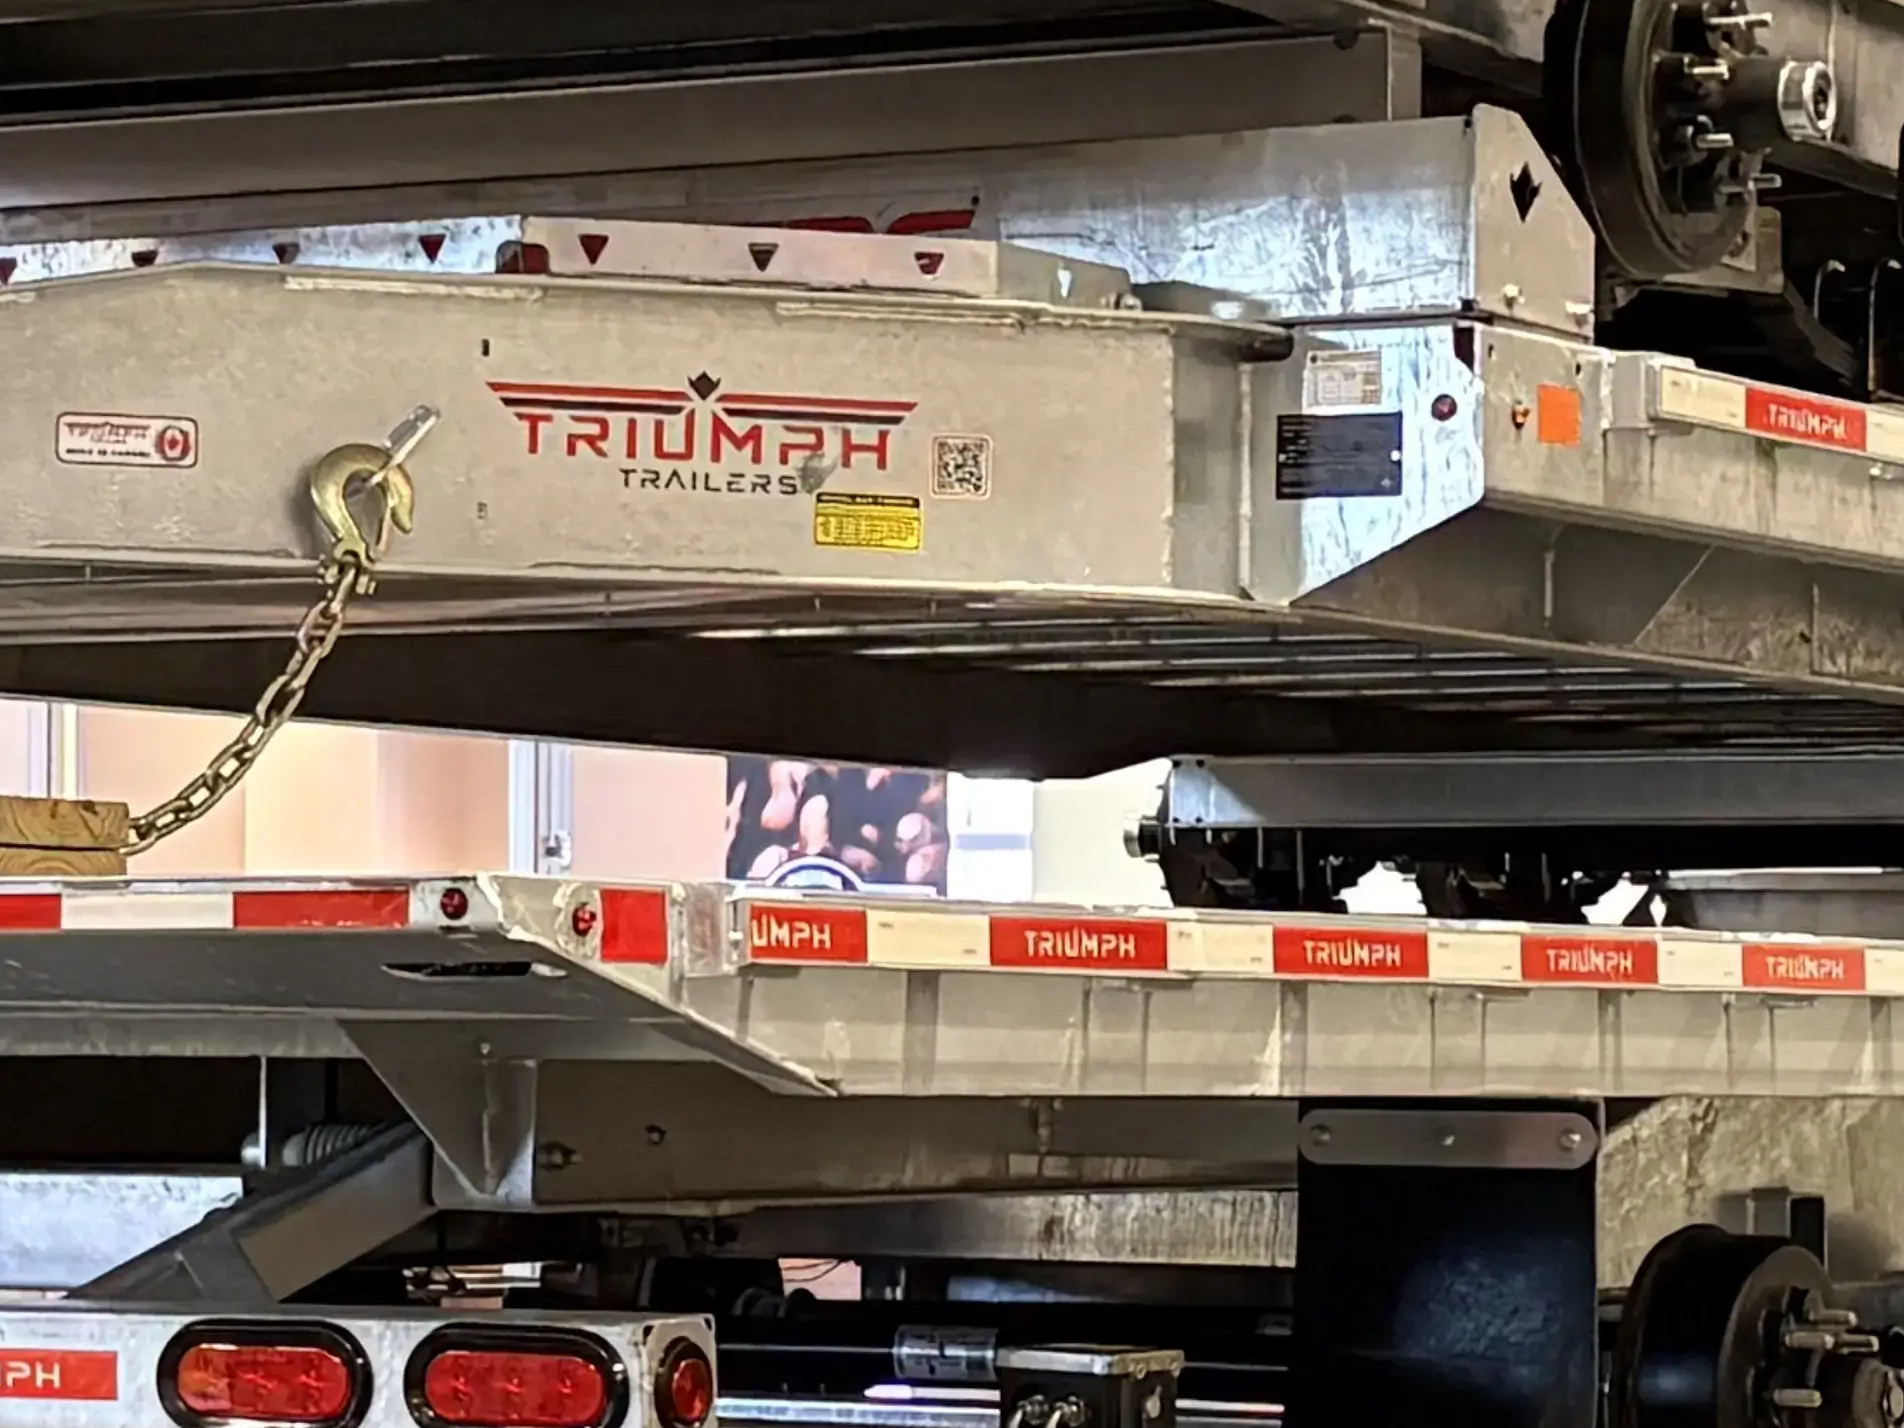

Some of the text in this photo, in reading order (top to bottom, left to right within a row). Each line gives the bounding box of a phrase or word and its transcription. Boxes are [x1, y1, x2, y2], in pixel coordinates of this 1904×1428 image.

[514, 408, 891, 469] TRIUMPH
[1767, 404, 1847, 441] TRIUMPH
[619, 469, 798, 496] TRAILERS
[1025, 928, 1136, 958] TRIUMPH
[1303, 938, 1401, 969] TRIUMPH
[1547, 942, 1635, 975] TRIUMPH
[1765, 954, 1844, 980] TRIUMPH
